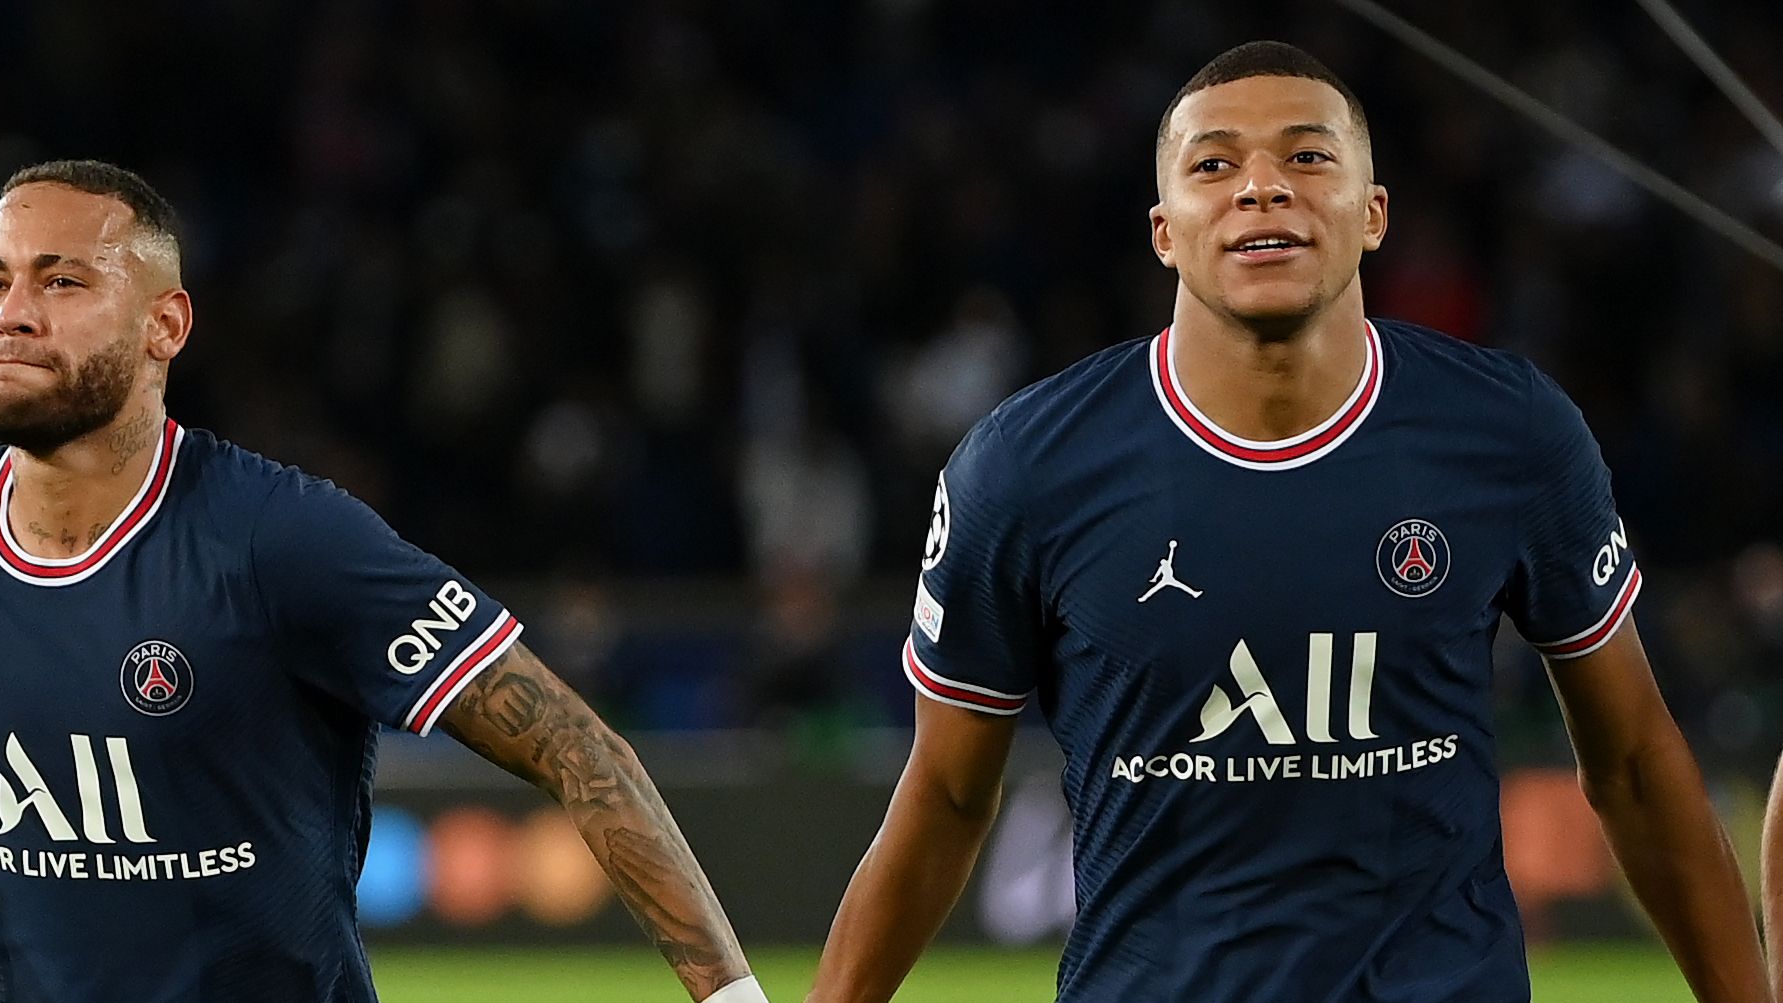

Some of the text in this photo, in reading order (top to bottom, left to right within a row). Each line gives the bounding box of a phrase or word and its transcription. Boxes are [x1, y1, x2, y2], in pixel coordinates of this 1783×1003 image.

[1389, 523, 1438, 543] PARIS
[1592, 516, 1628, 586] QN
[387, 579, 477, 675] QNB
[130, 644, 177, 665] PARIS
[1111, 734, 1459, 783] ACCOR LIVE LIMITLESS
[22, 849, 89, 879] LIVE
[96, 841, 256, 880] LIMITLESS
